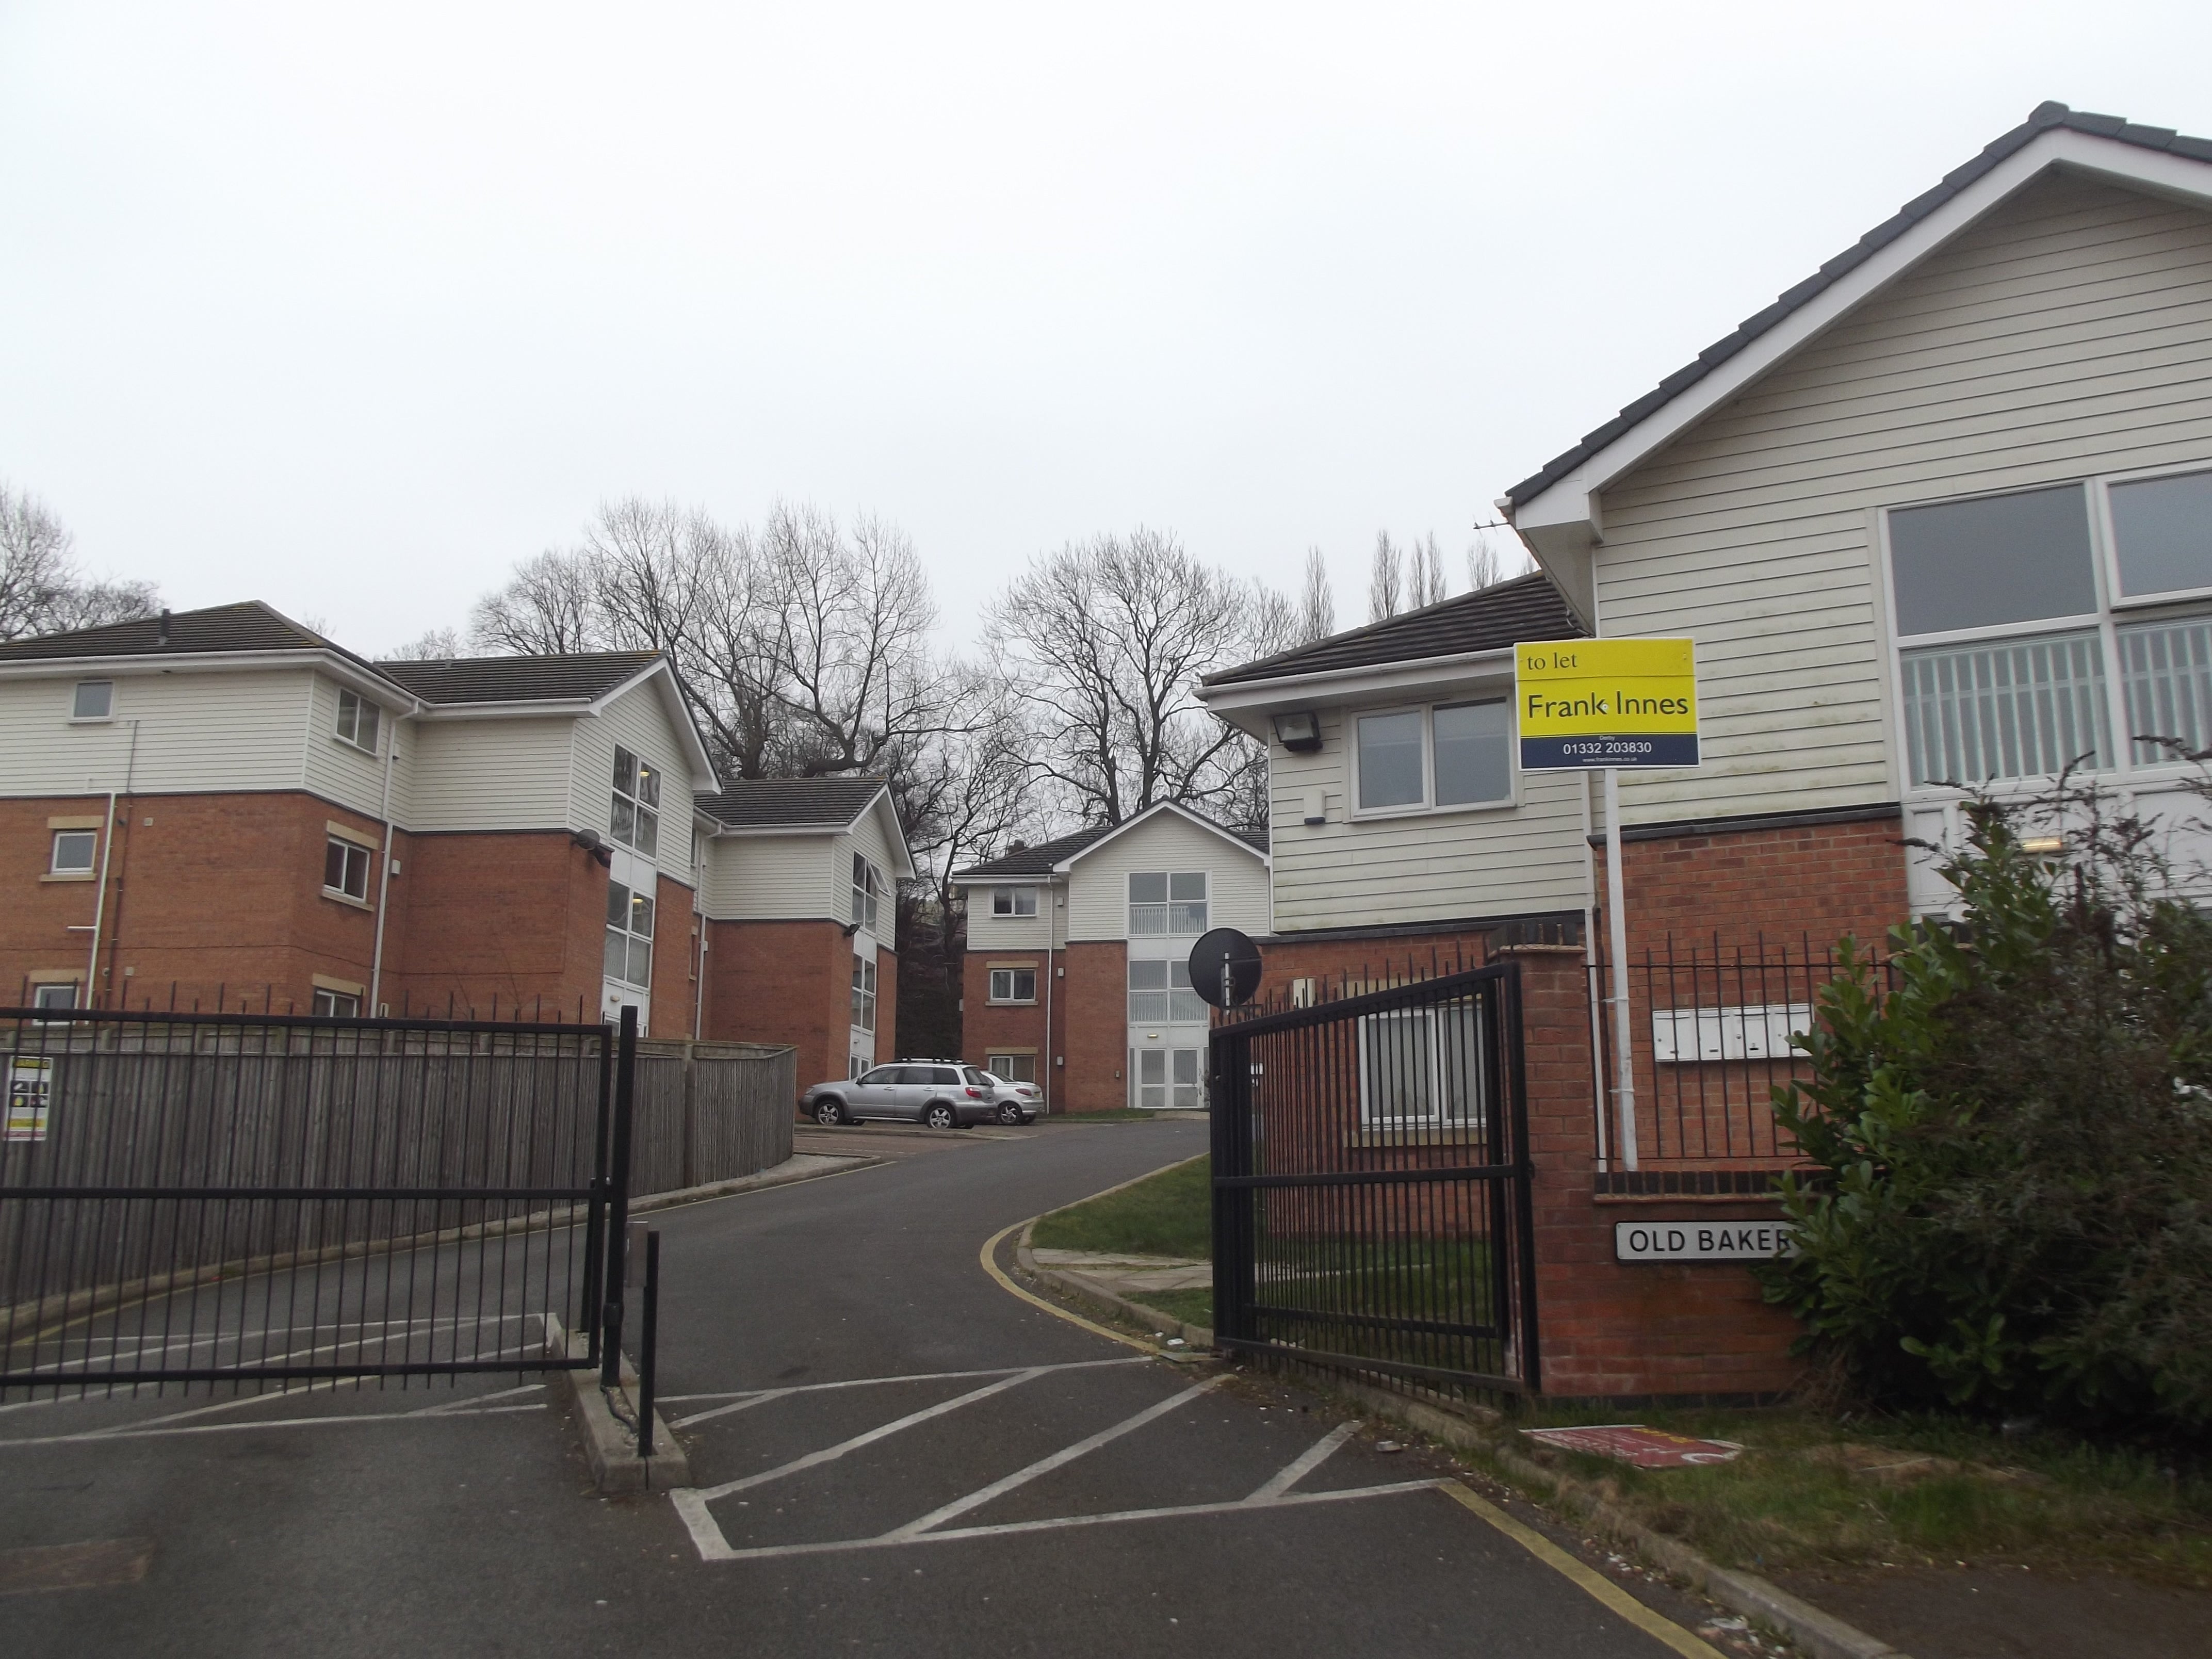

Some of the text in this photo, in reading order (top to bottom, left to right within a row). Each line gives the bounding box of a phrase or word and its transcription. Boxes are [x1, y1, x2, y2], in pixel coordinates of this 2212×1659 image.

[1527, 653, 1577, 670] to let
[1528, 691, 1688, 718] Frank Innes
[1563, 742, 1652, 754] 01332 203830
[1630, 1229, 1685, 1252] OLD
